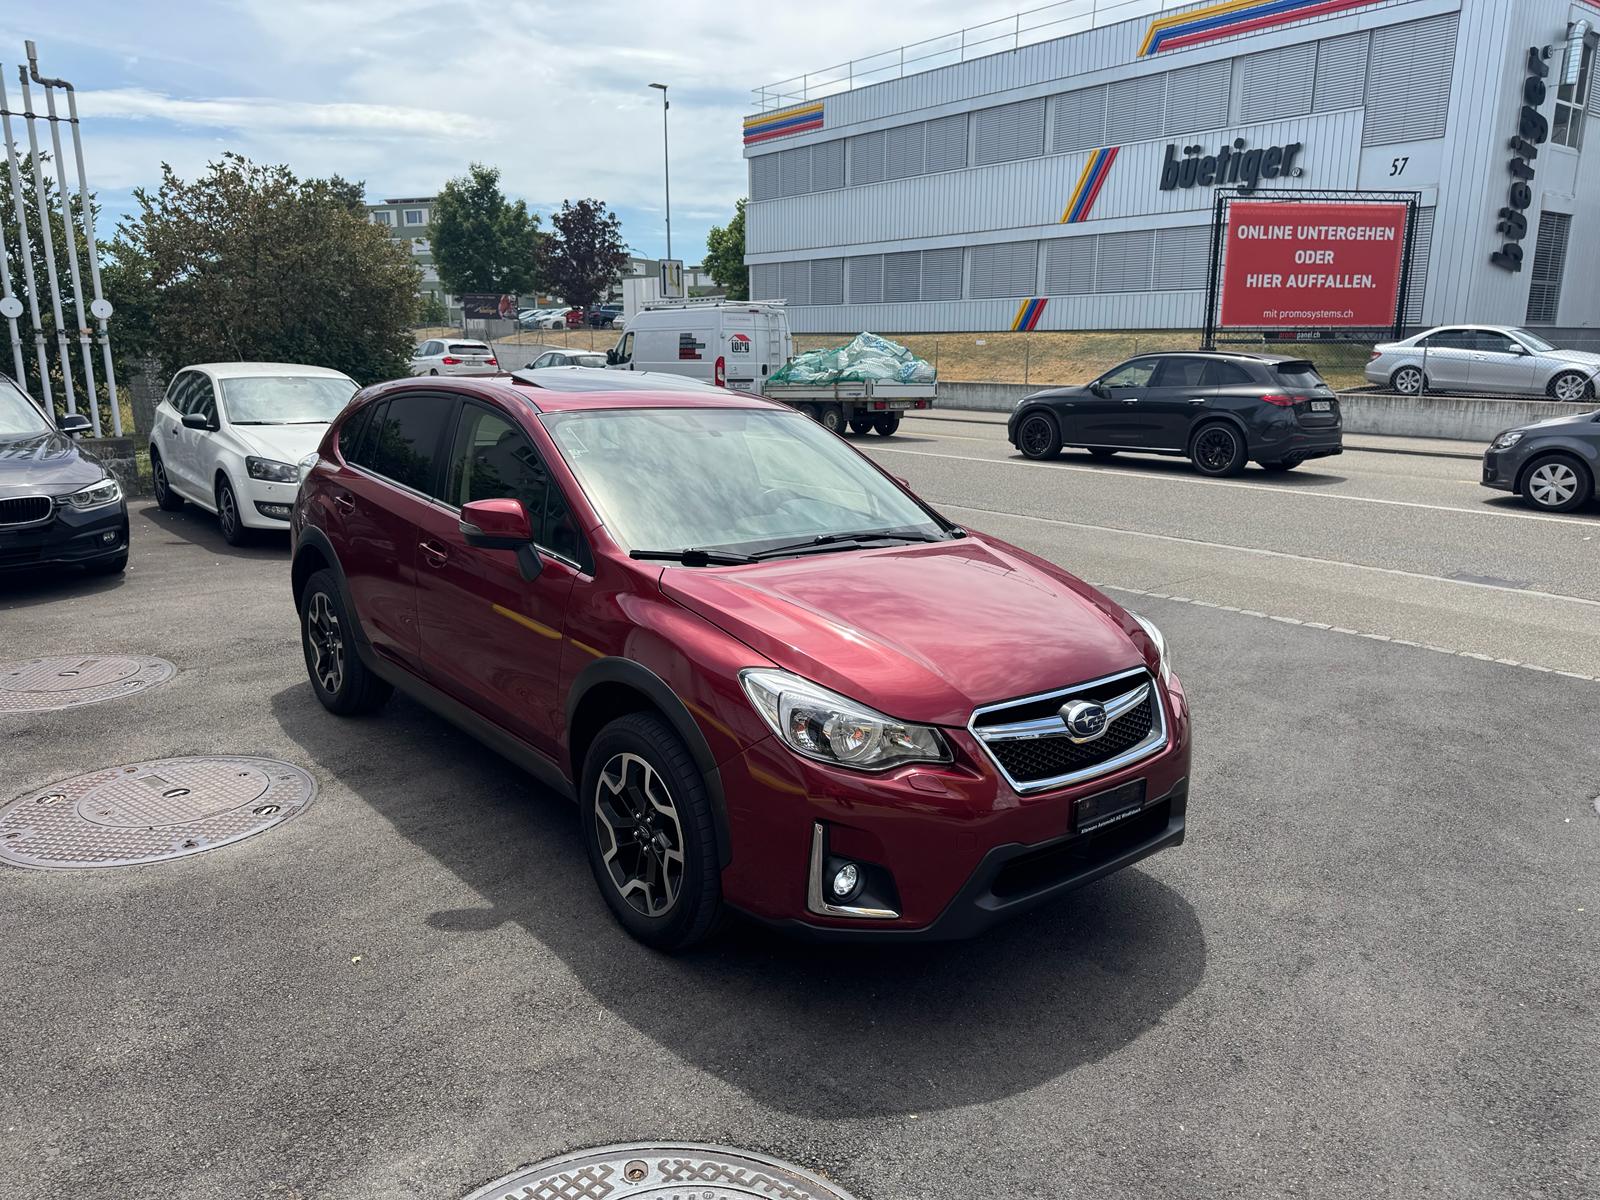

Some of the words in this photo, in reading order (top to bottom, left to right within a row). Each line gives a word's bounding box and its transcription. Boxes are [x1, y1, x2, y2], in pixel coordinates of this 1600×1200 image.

[1389, 157, 1409, 176] 57
[1491, 46, 1550, 272] büetiger
[1237, 225, 1293, 240] ONLINE
[1296, 225, 1395, 241] UNTERGEHEN
[1294, 250, 1334, 264] ODER
[1246, 273, 1282, 288] HIER
[1286, 274, 1376, 288] AUFFALLEN.
[1263, 309, 1278, 318] mit
[1279, 309, 1354, 319] promosystems.ch
